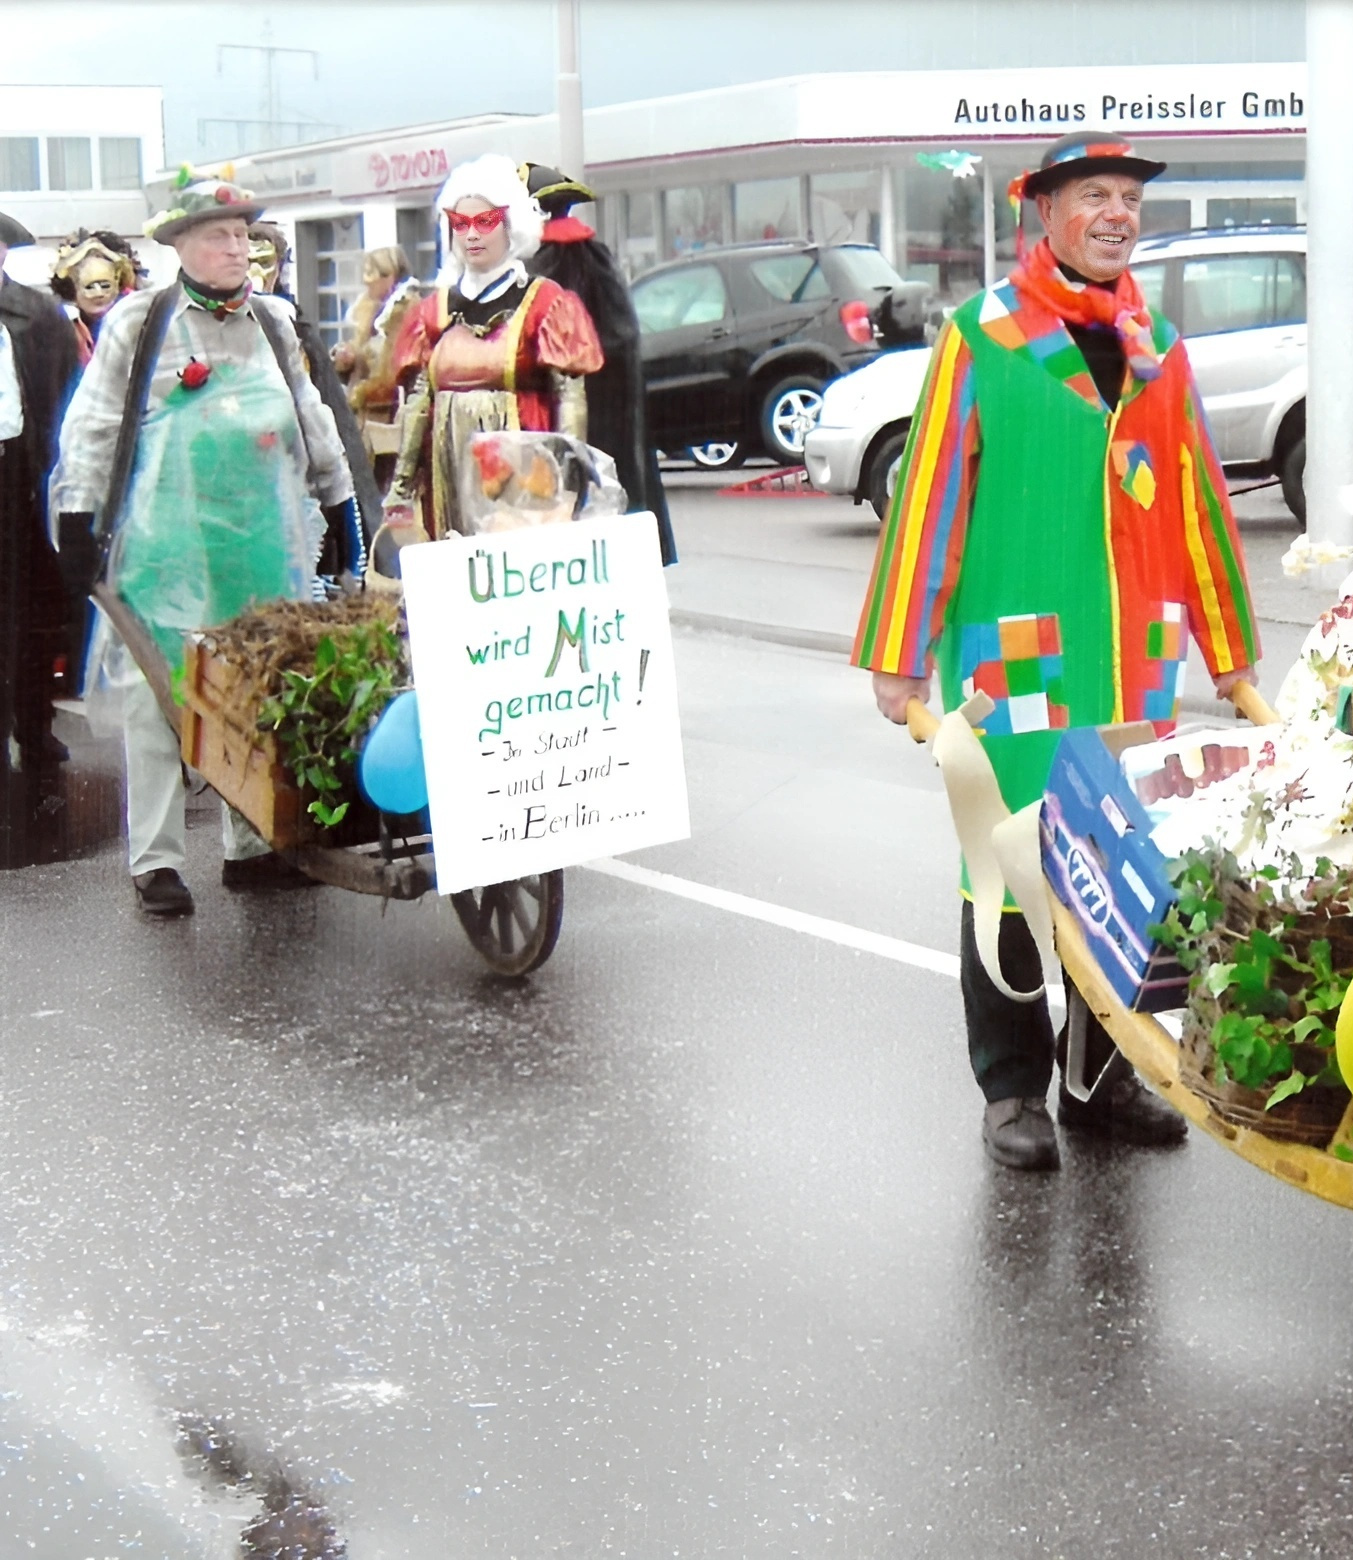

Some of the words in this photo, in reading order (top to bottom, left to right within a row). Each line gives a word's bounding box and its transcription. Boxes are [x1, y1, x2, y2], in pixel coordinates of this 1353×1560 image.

[954, 98, 1087, 124] Autohaus
[1102, 94, 1227, 120] Preissler
[1242, 91, 1305, 118] Gmb
[468, 539, 609, 604] Überall
[466, 625, 531, 665] wird
[544, 607, 625, 678] Mist
